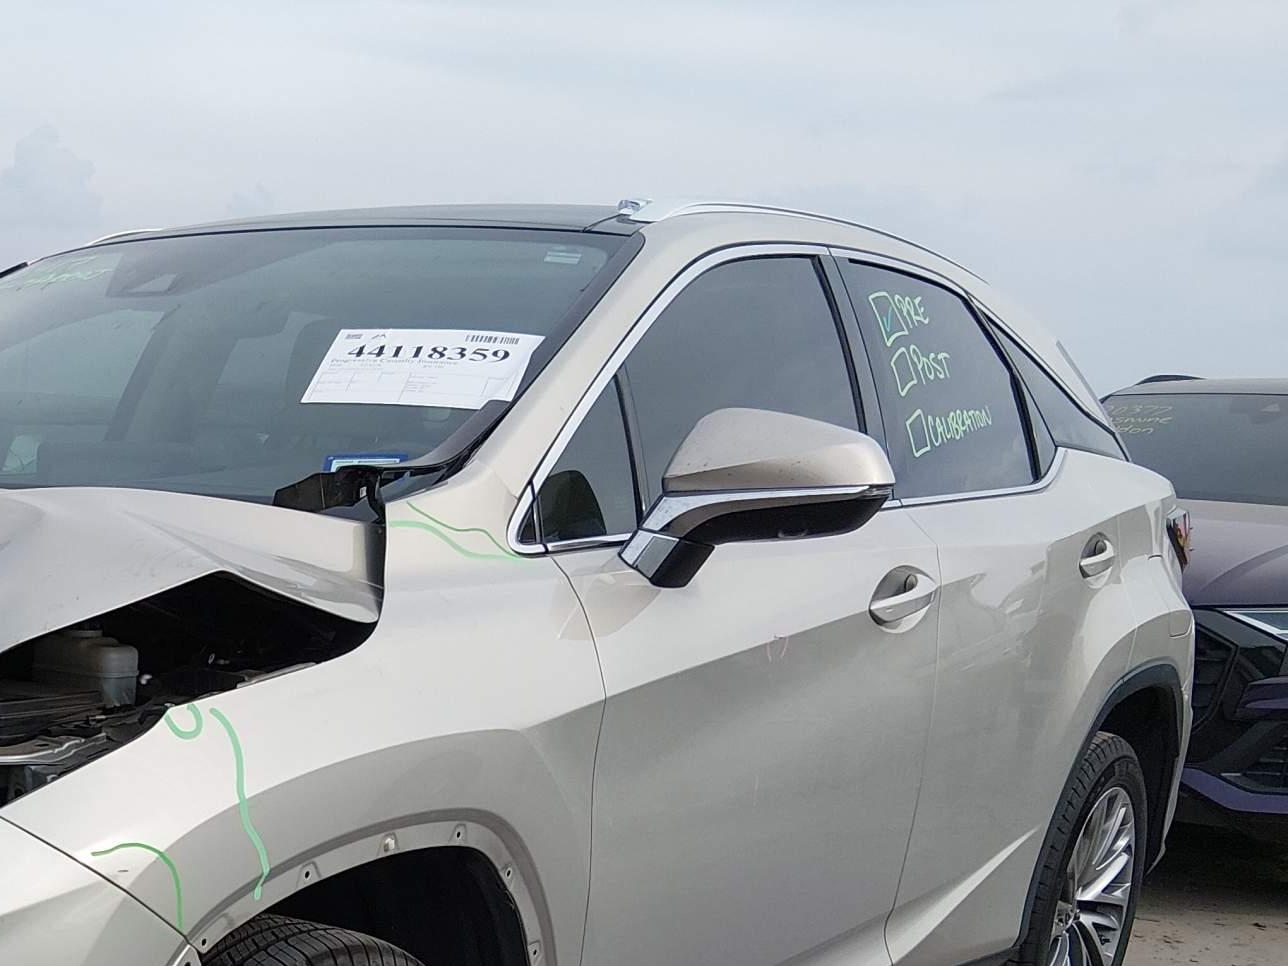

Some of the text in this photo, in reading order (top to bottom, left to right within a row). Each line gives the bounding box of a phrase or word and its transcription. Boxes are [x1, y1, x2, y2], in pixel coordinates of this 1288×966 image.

[894, 294, 929, 328] PRE
[348, 344, 511, 363] 44118359
[910, 344, 951, 385] POST
[928, 406, 992, 446] CALIBRATION
